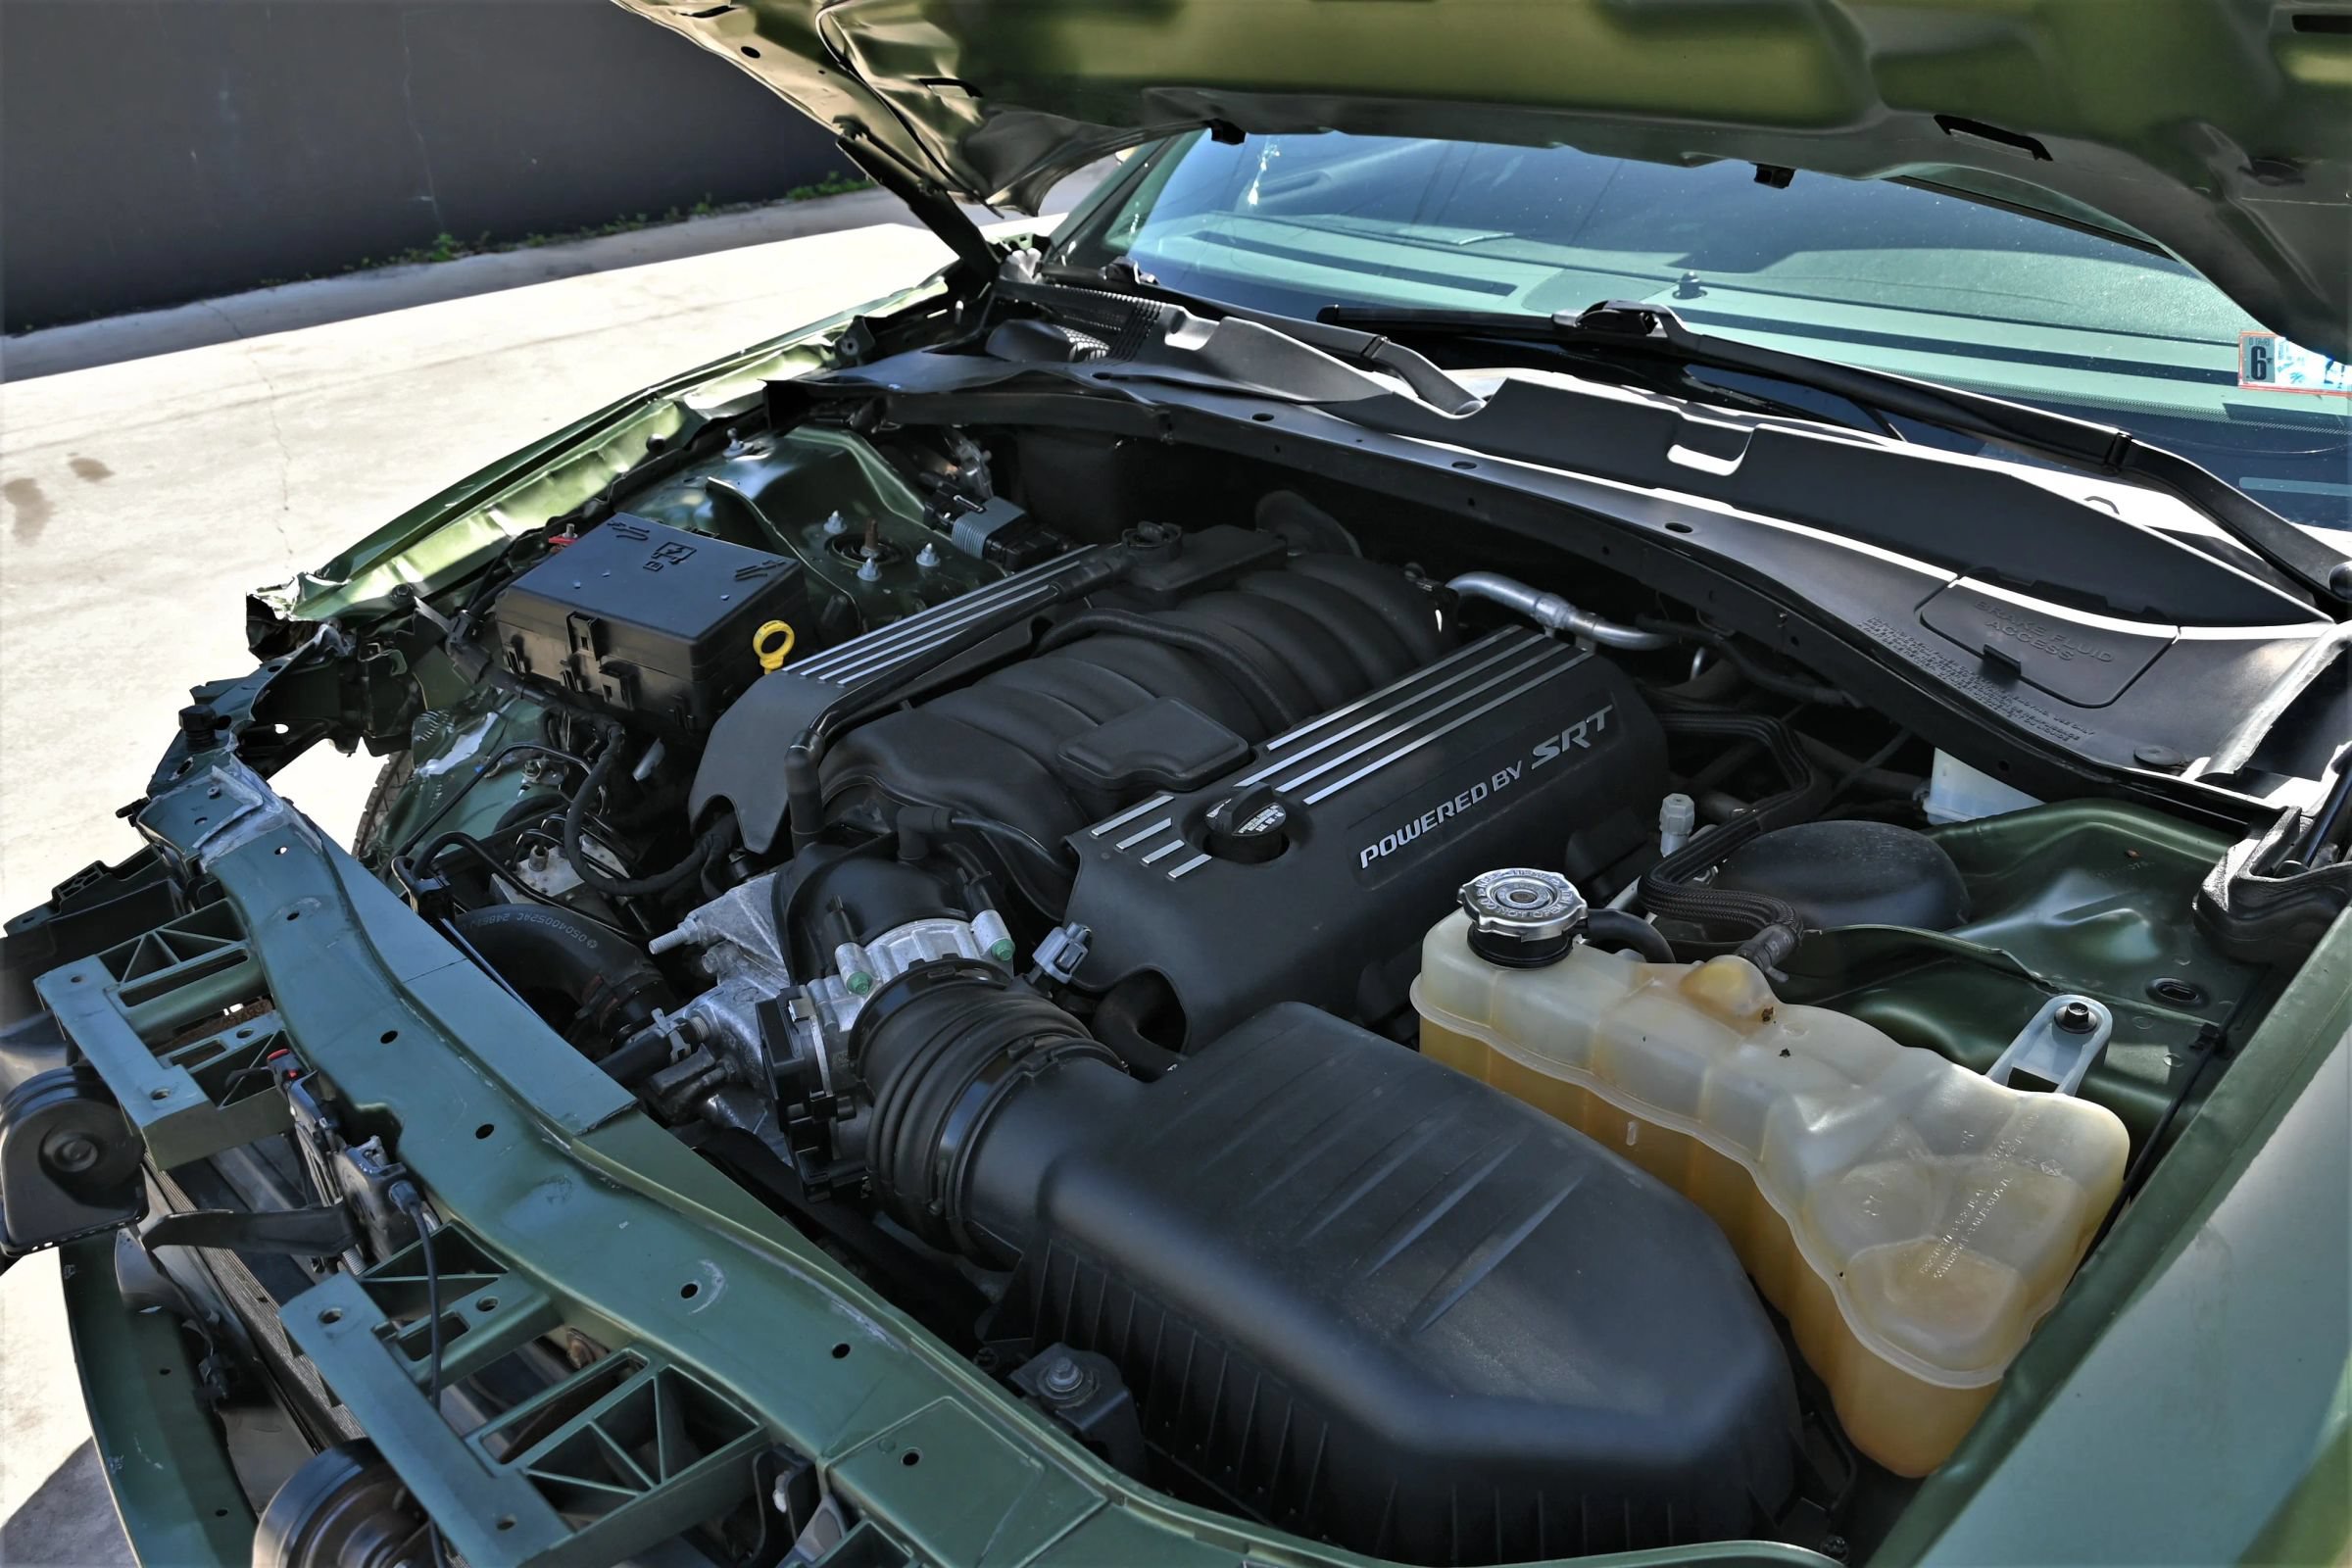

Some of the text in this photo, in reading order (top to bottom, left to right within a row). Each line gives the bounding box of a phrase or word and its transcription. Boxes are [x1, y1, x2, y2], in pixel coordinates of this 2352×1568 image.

[2250, 345, 2267, 380] 6
[1974, 601, 2115, 662] BRAKE FLUID
[1984, 619, 2076, 662] ACCESS
[1359, 782, 1489, 869] POWERED
[1492, 760, 1523, 793] BY
[1531, 704, 1614, 770] SRT
